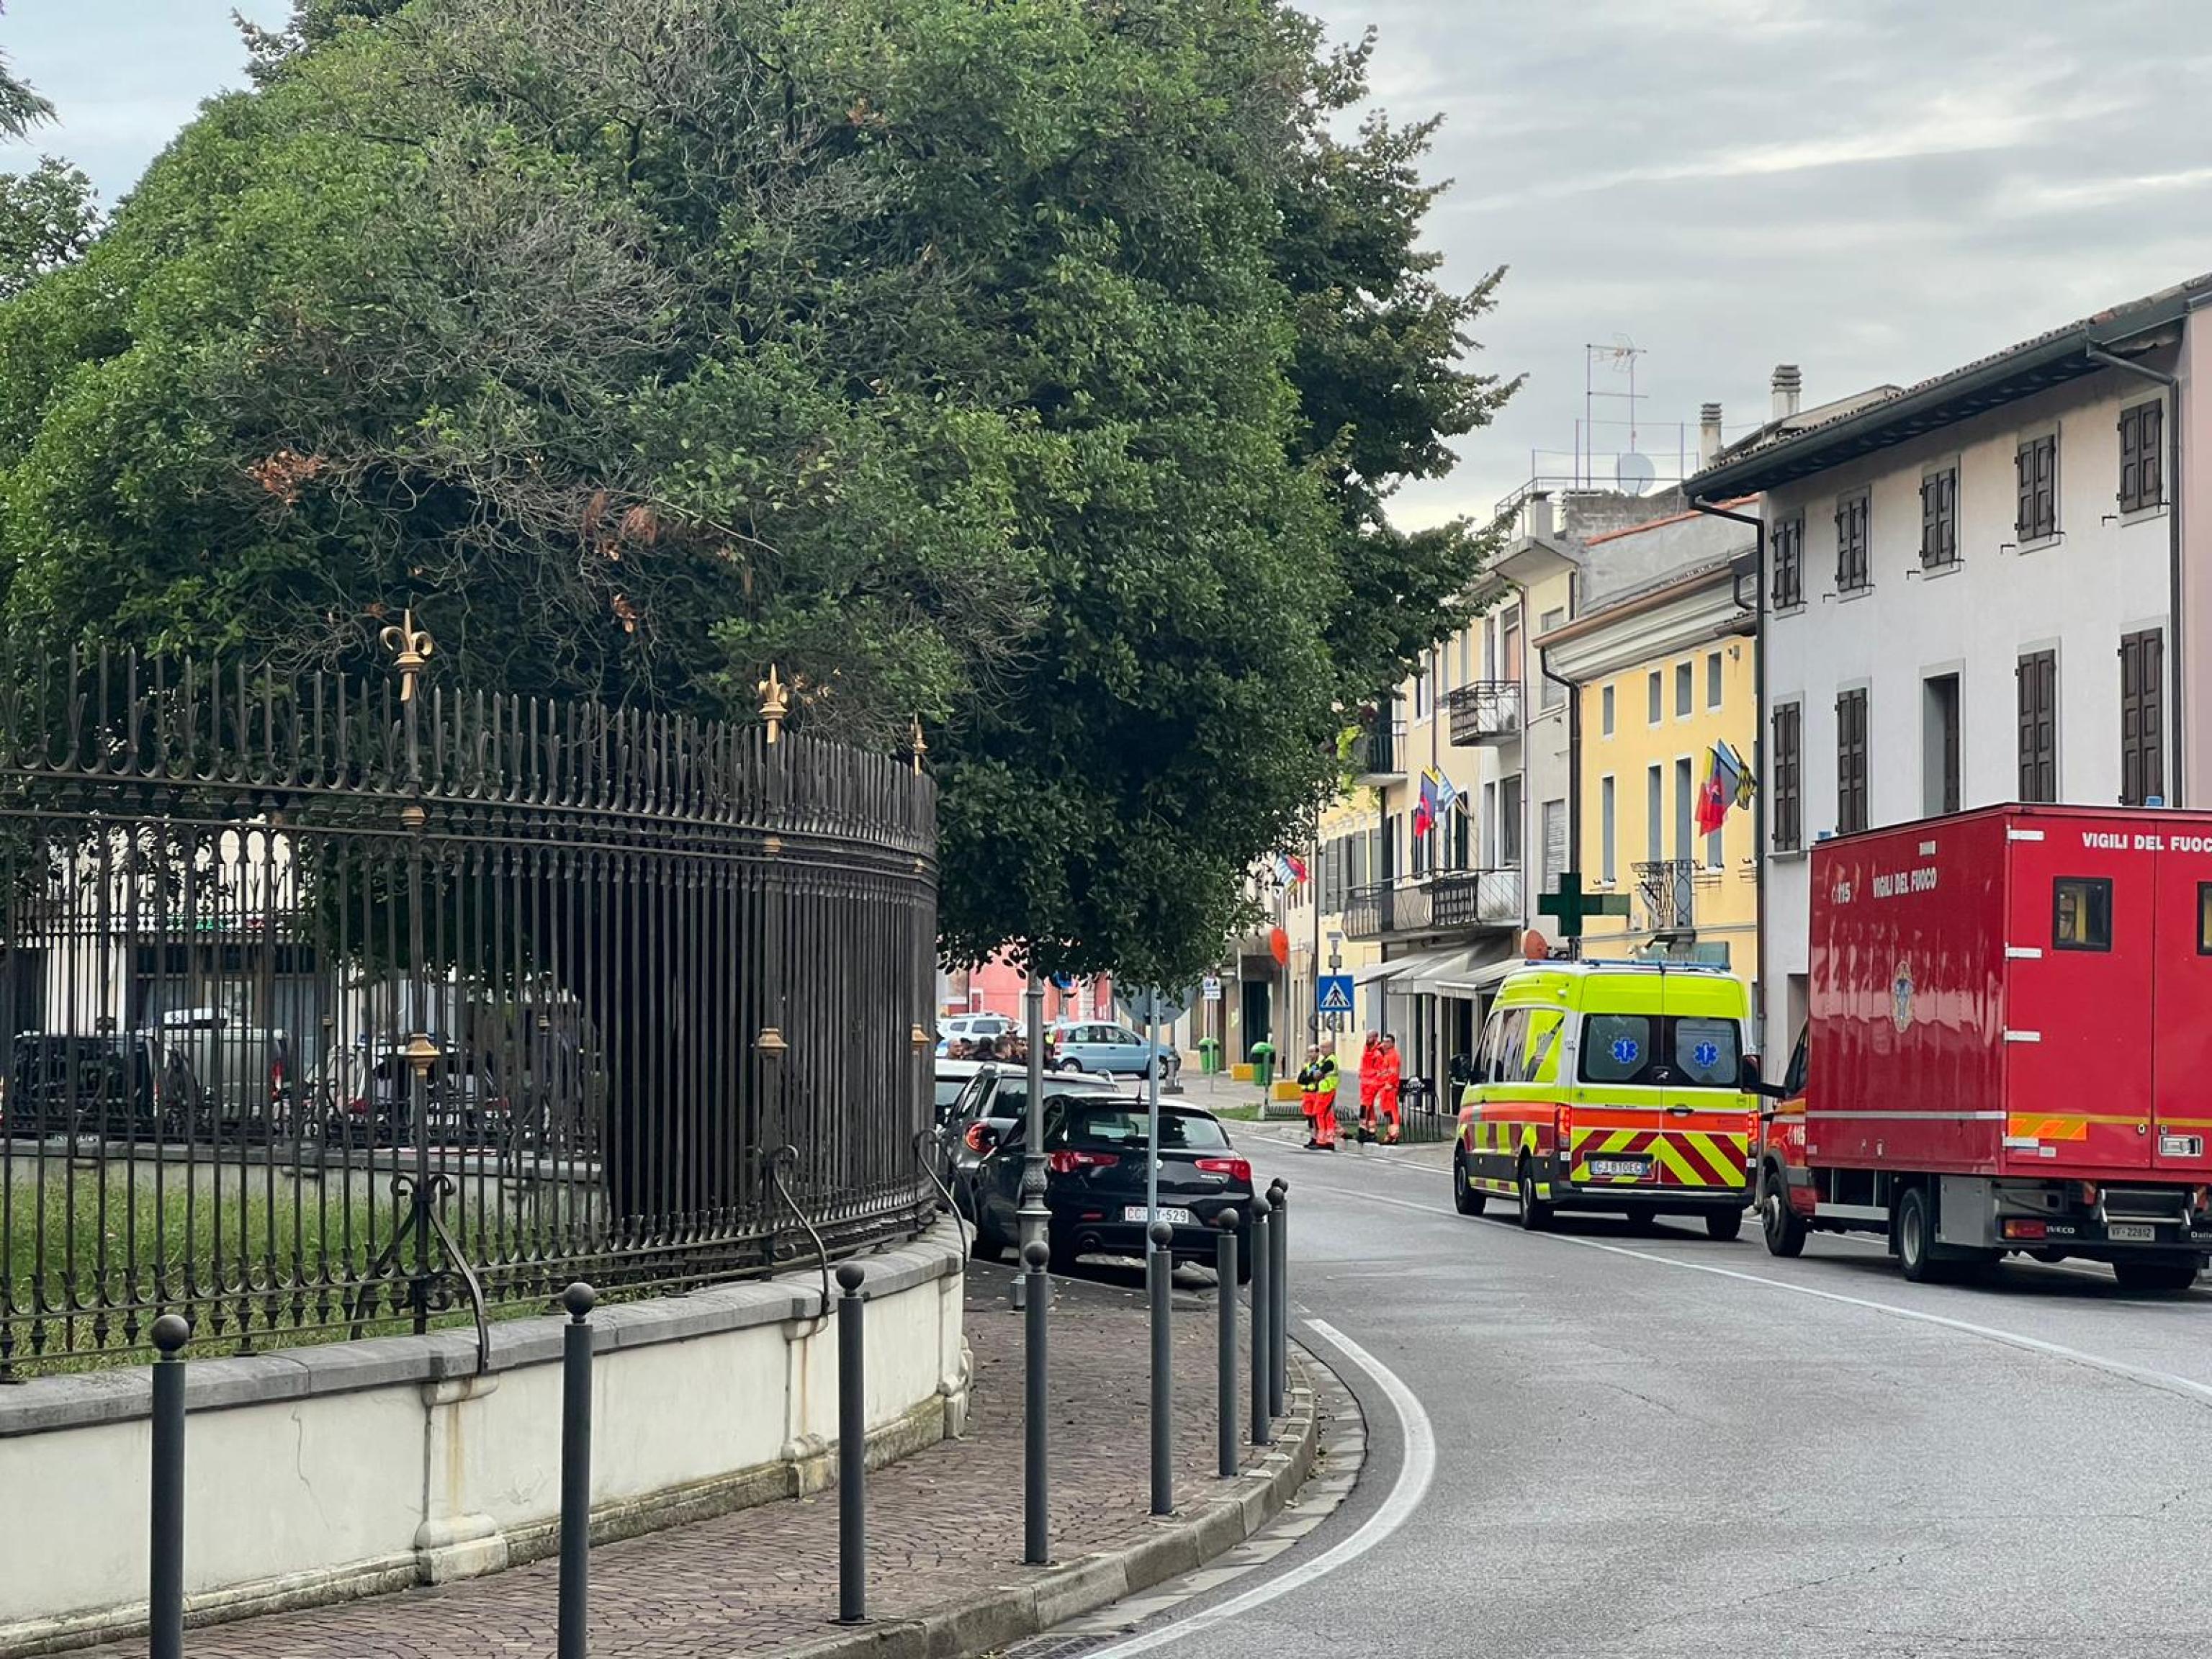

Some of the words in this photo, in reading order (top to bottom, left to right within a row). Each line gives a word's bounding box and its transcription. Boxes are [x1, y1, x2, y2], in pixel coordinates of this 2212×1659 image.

[2082, 832, 2128, 850] VIGILI
[2134, 835, 2164, 851] DEL
[1873, 875, 1893, 899] VIGILI
[1895, 872, 1909, 895] DEL
[1911, 866, 1937, 893] FUOCO
